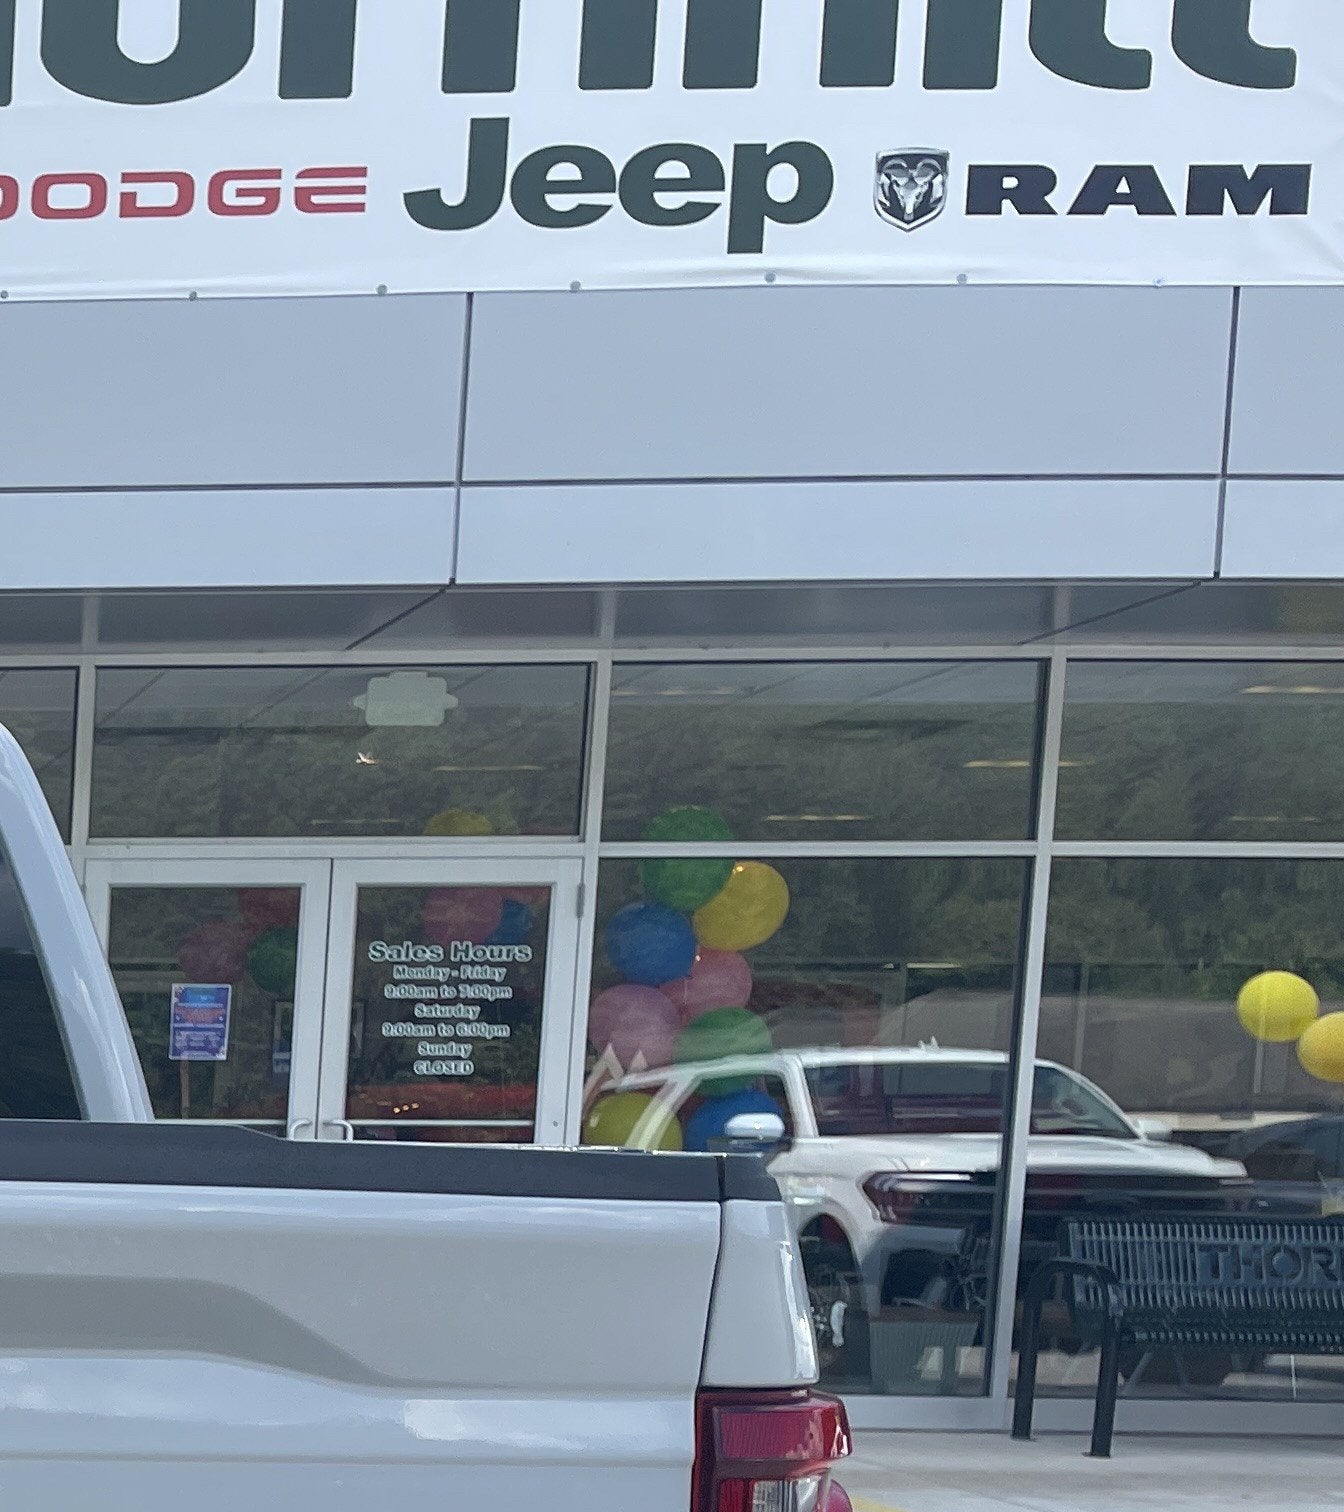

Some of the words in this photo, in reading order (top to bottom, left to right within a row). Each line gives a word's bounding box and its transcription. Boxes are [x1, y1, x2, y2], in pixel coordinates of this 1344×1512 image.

[403, 117, 834, 254] Jeep
[965, 163, 1313, 216] RAM
[368, 940, 444, 963] Sales
[450, 940, 533, 962] Hours
[392, 964, 450, 982] Monday
[460, 964, 507, 982] Friday
[439, 984, 457, 998] to
[414, 1003, 481, 1020] Saturday
[437, 1022, 455, 1037] to
[417, 1041, 473, 1059] Sunday
[413, 1060, 474, 1076] CLOSED
[1197, 1243, 1344, 1282] THOR
